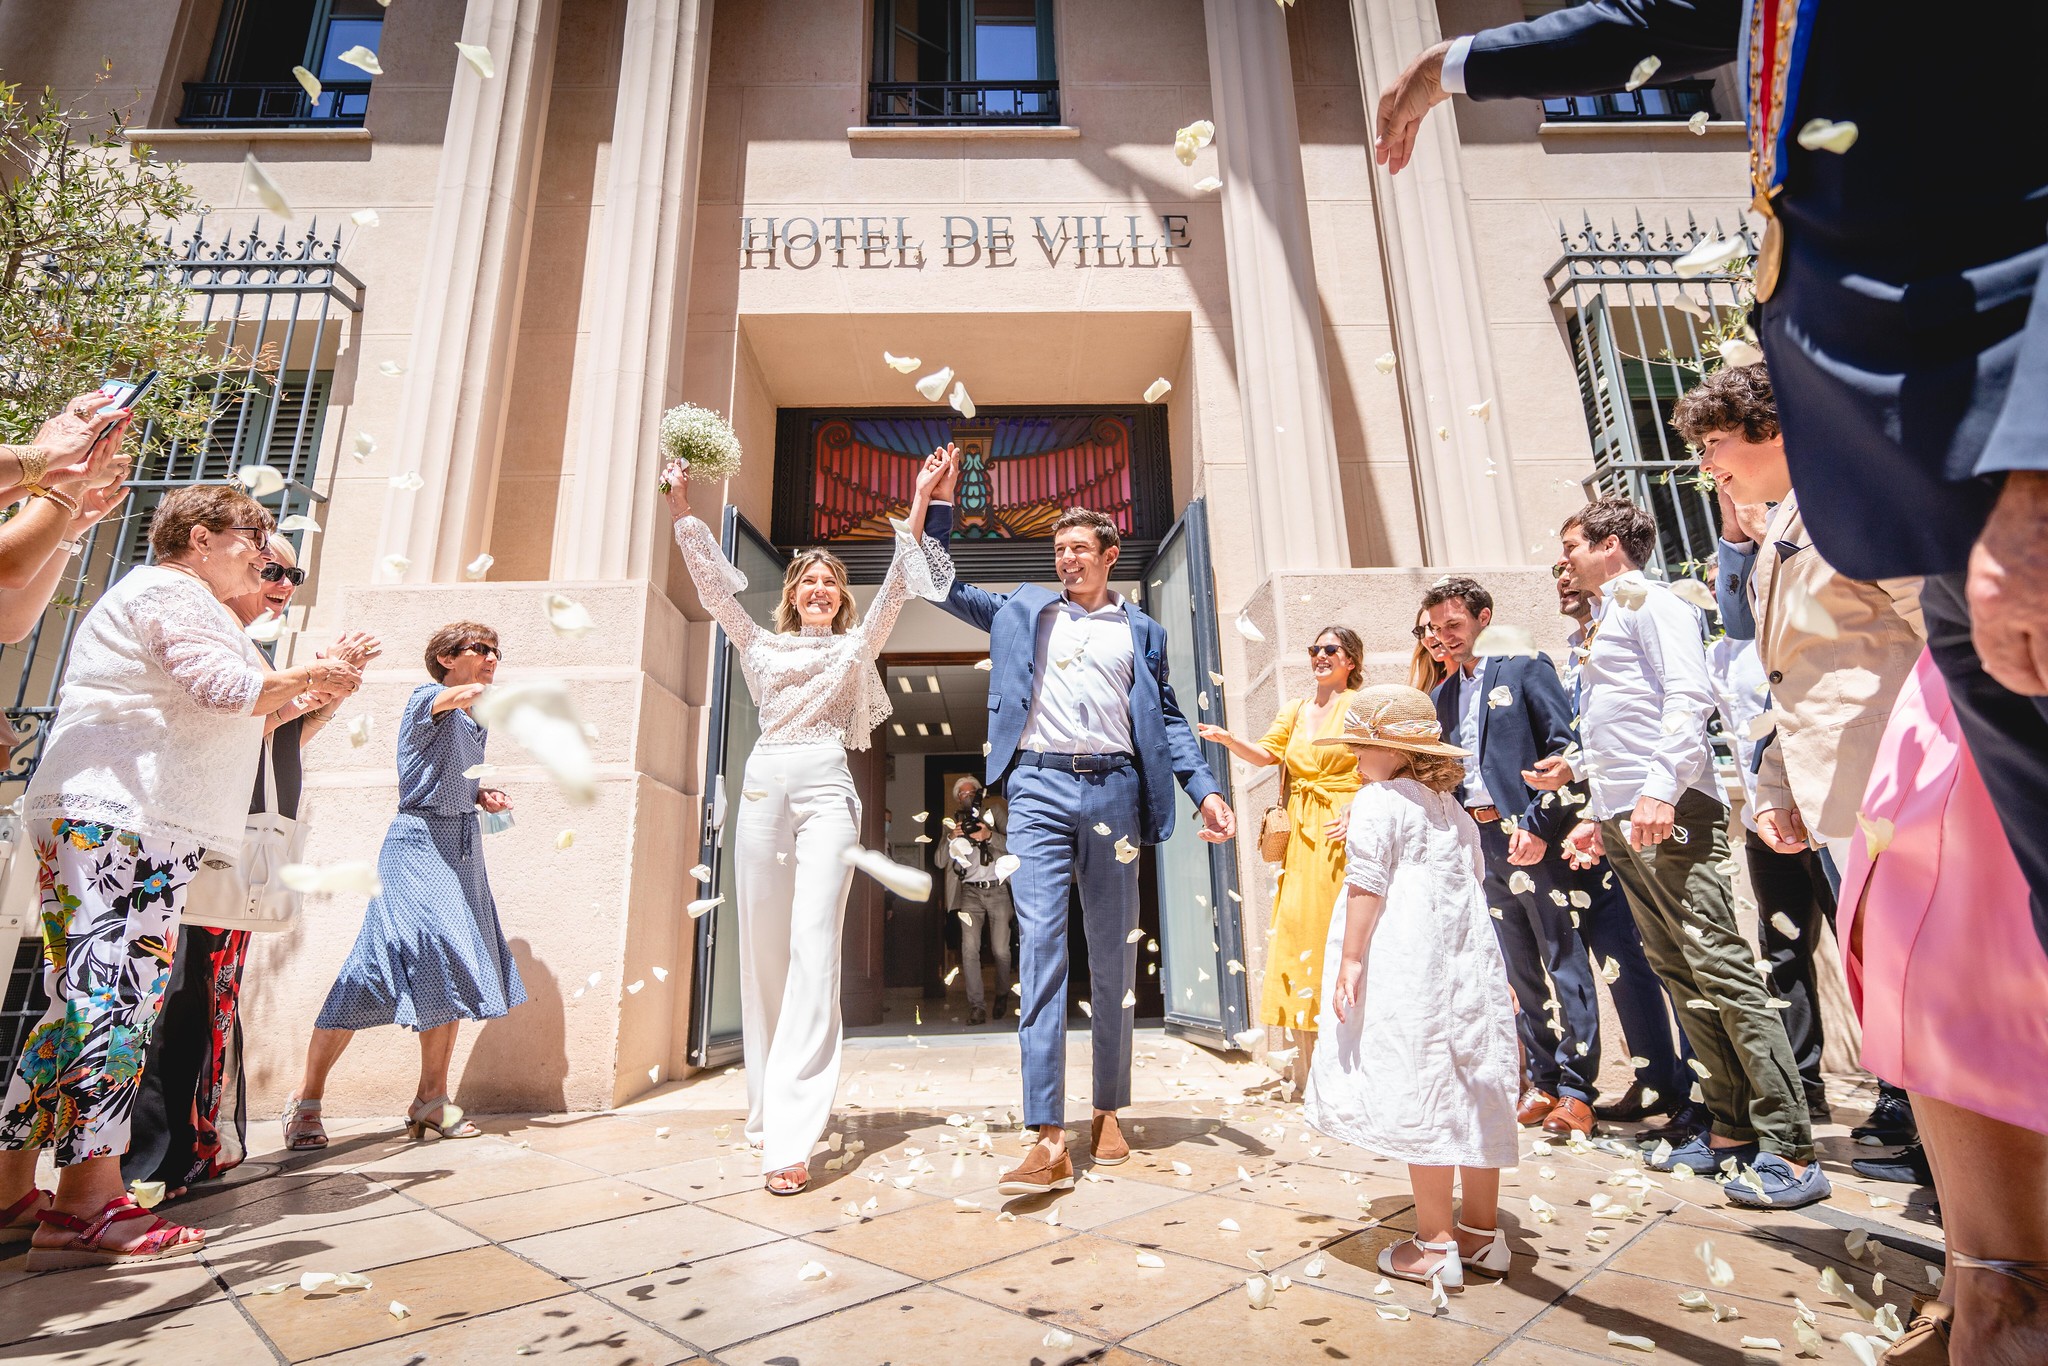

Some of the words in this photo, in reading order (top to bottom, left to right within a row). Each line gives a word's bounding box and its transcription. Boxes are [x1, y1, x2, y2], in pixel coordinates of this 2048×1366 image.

[738, 216, 925, 251] HOTEL
[940, 215, 1015, 250] DE
[1029, 214, 1192, 250] VILLE
